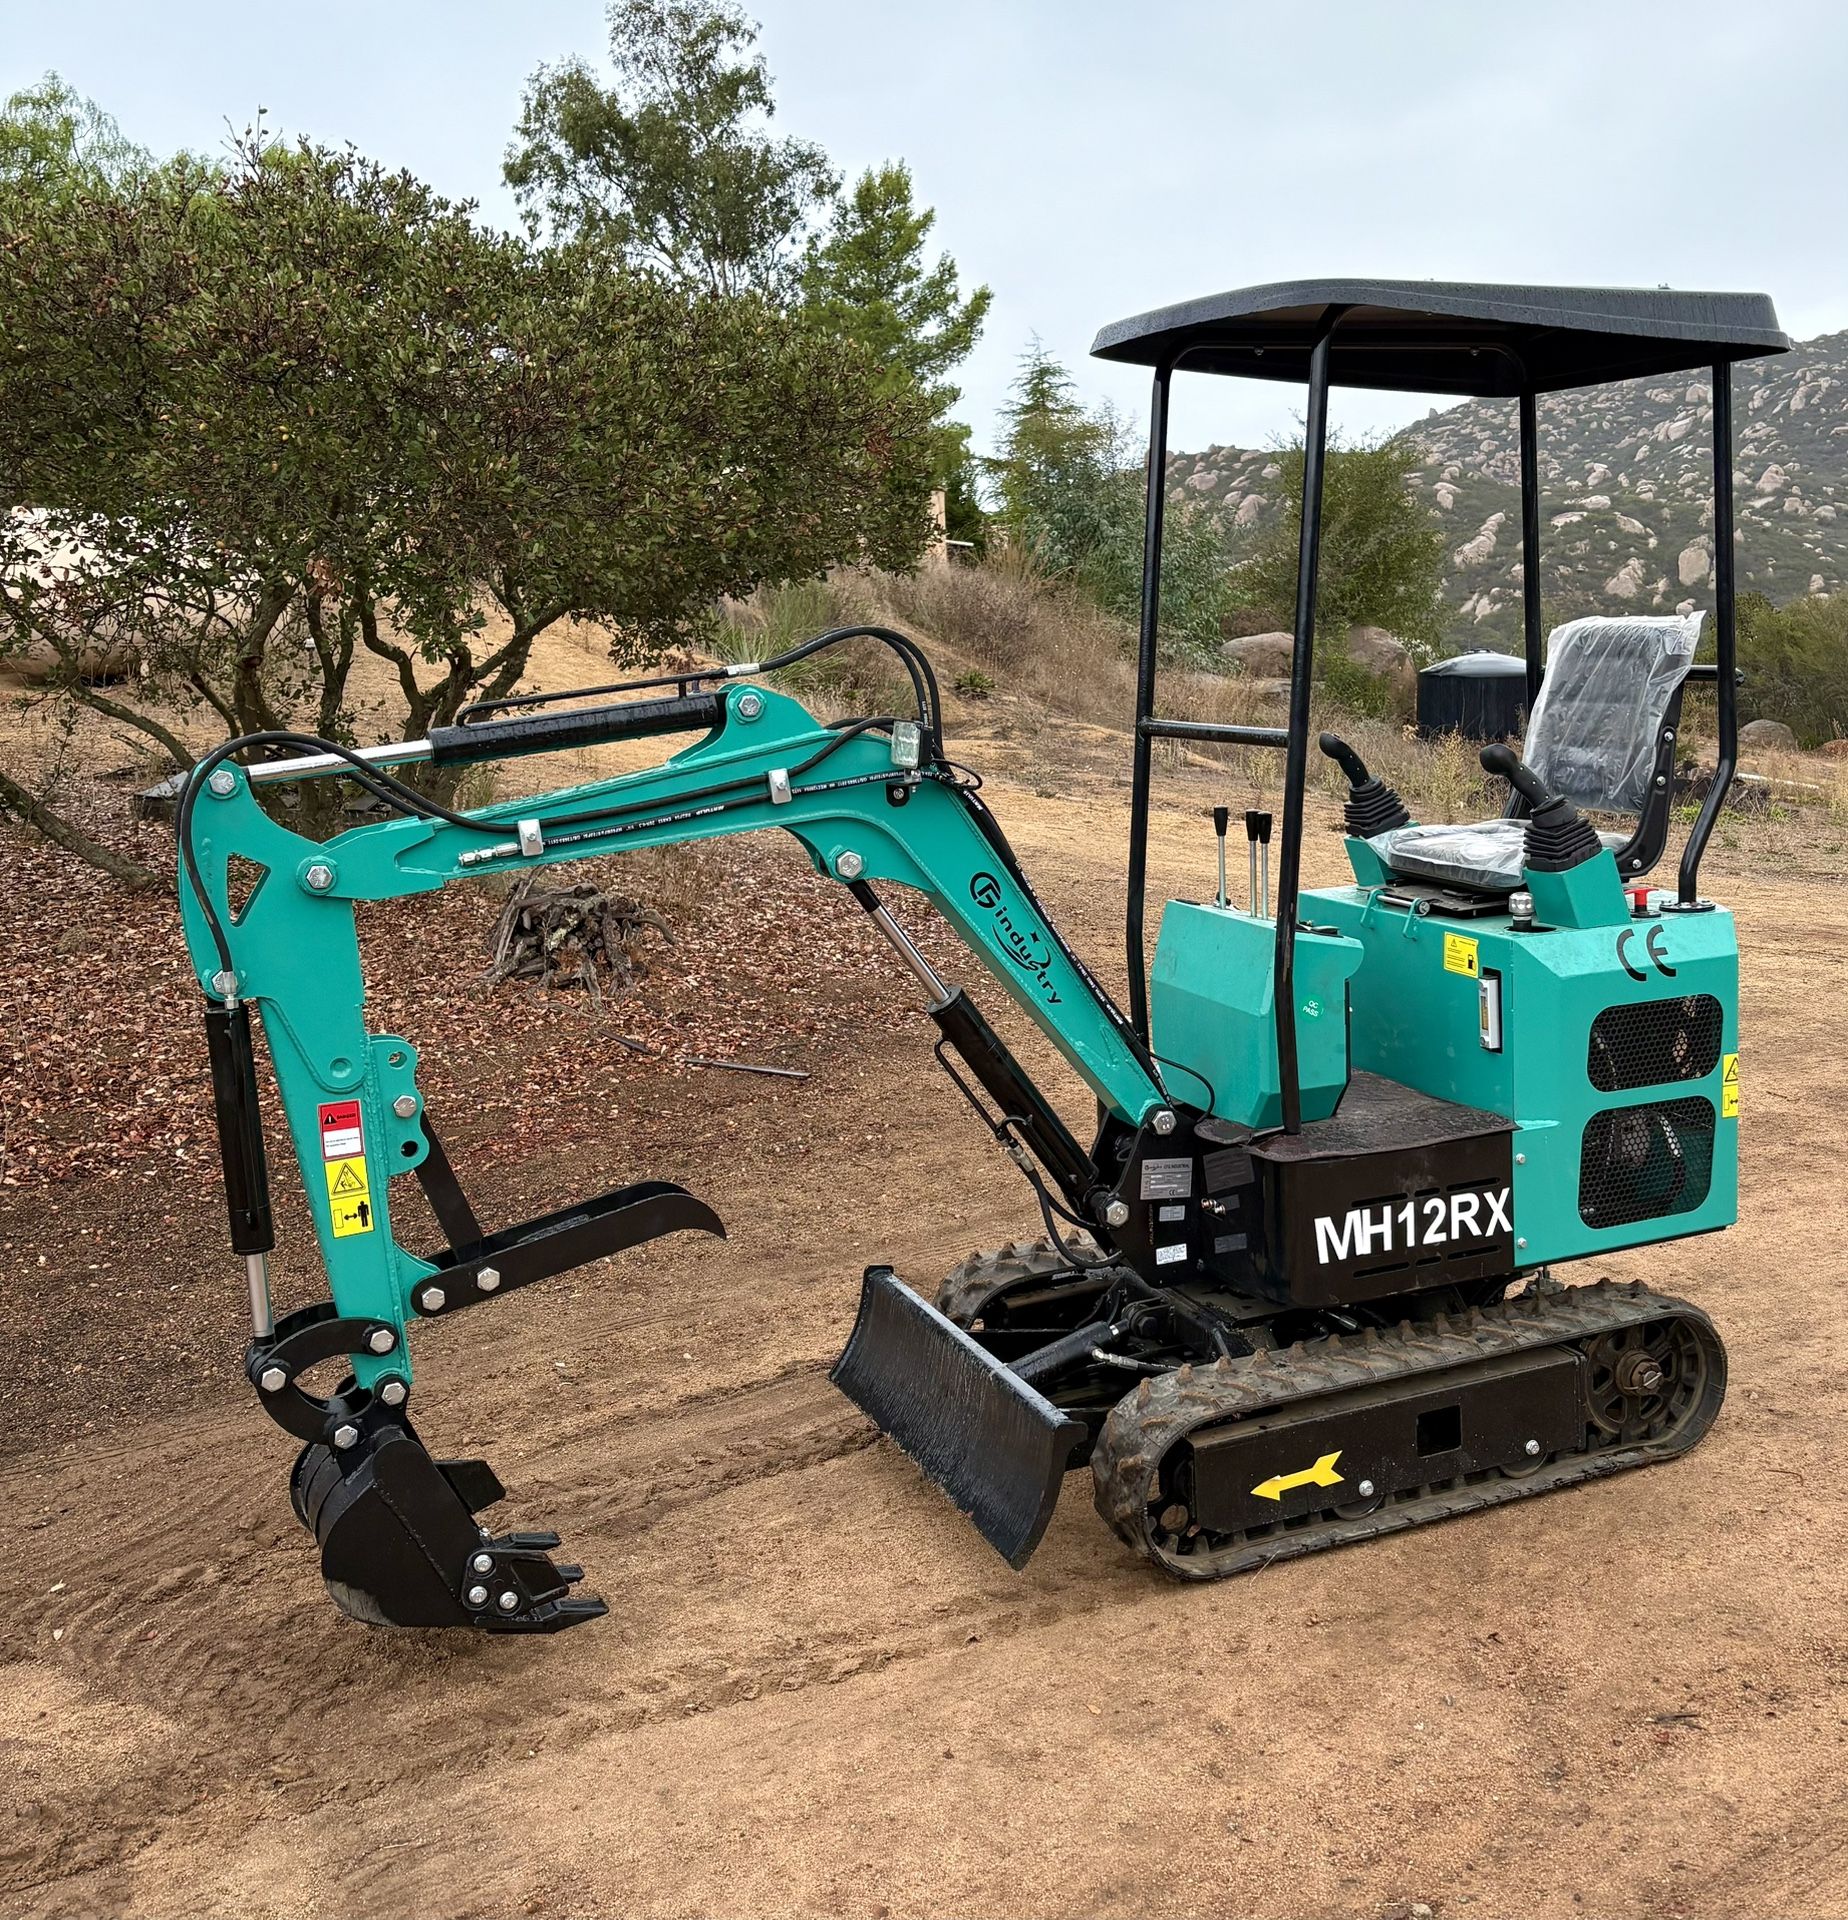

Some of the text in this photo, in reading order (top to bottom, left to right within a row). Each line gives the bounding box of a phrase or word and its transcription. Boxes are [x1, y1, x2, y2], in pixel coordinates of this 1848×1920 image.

[1616, 924, 1676, 981] CE
[1303, 1006, 1319, 1016] PASS
[1309, 1000, 1318, 1008] QC
[1314, 1187, 1513, 1265] MH12RX
